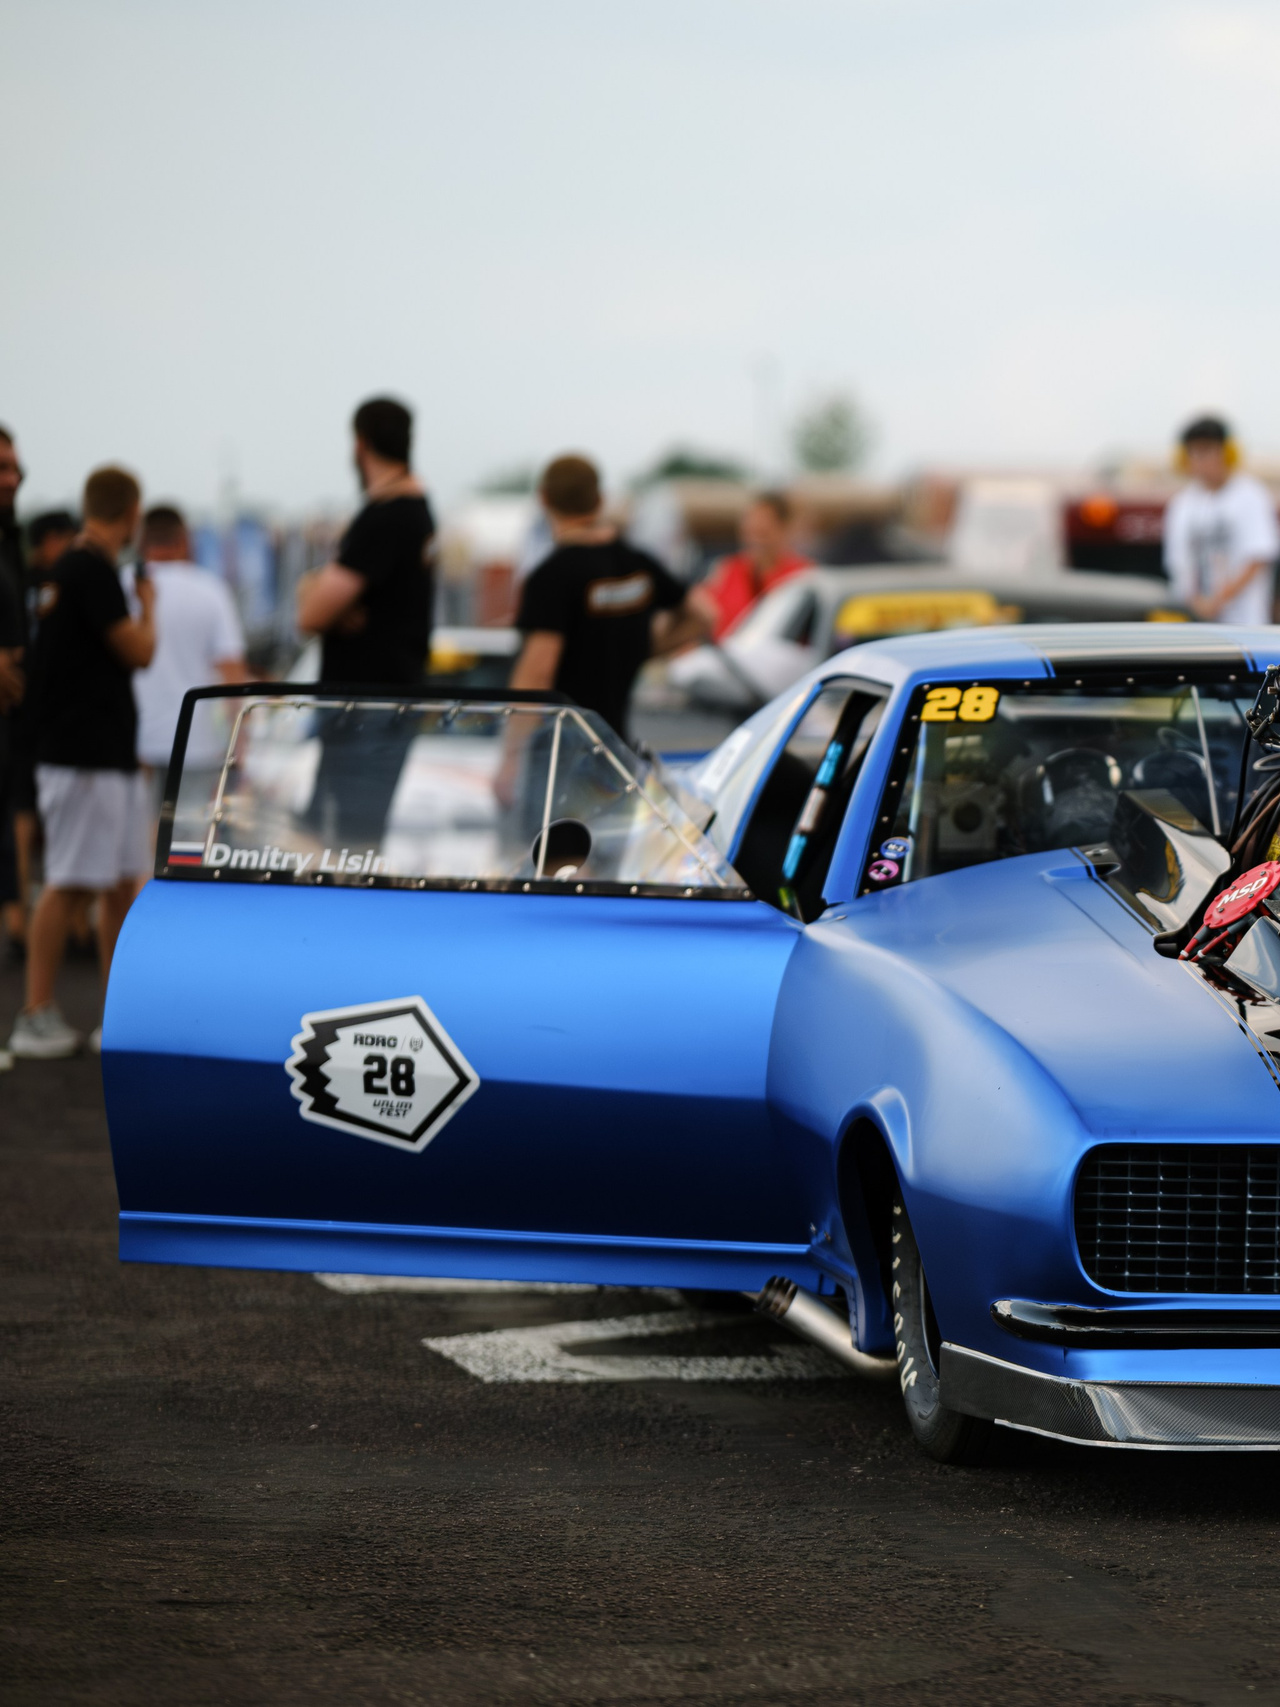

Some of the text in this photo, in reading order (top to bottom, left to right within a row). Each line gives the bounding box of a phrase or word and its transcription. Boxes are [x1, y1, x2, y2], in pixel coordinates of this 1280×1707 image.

[920, 687, 999, 722] 28
[207, 843, 390, 877] Dmitry Lisin
[1215, 876, 1269, 909] MSD
[363, 1052, 415, 1097] 28
